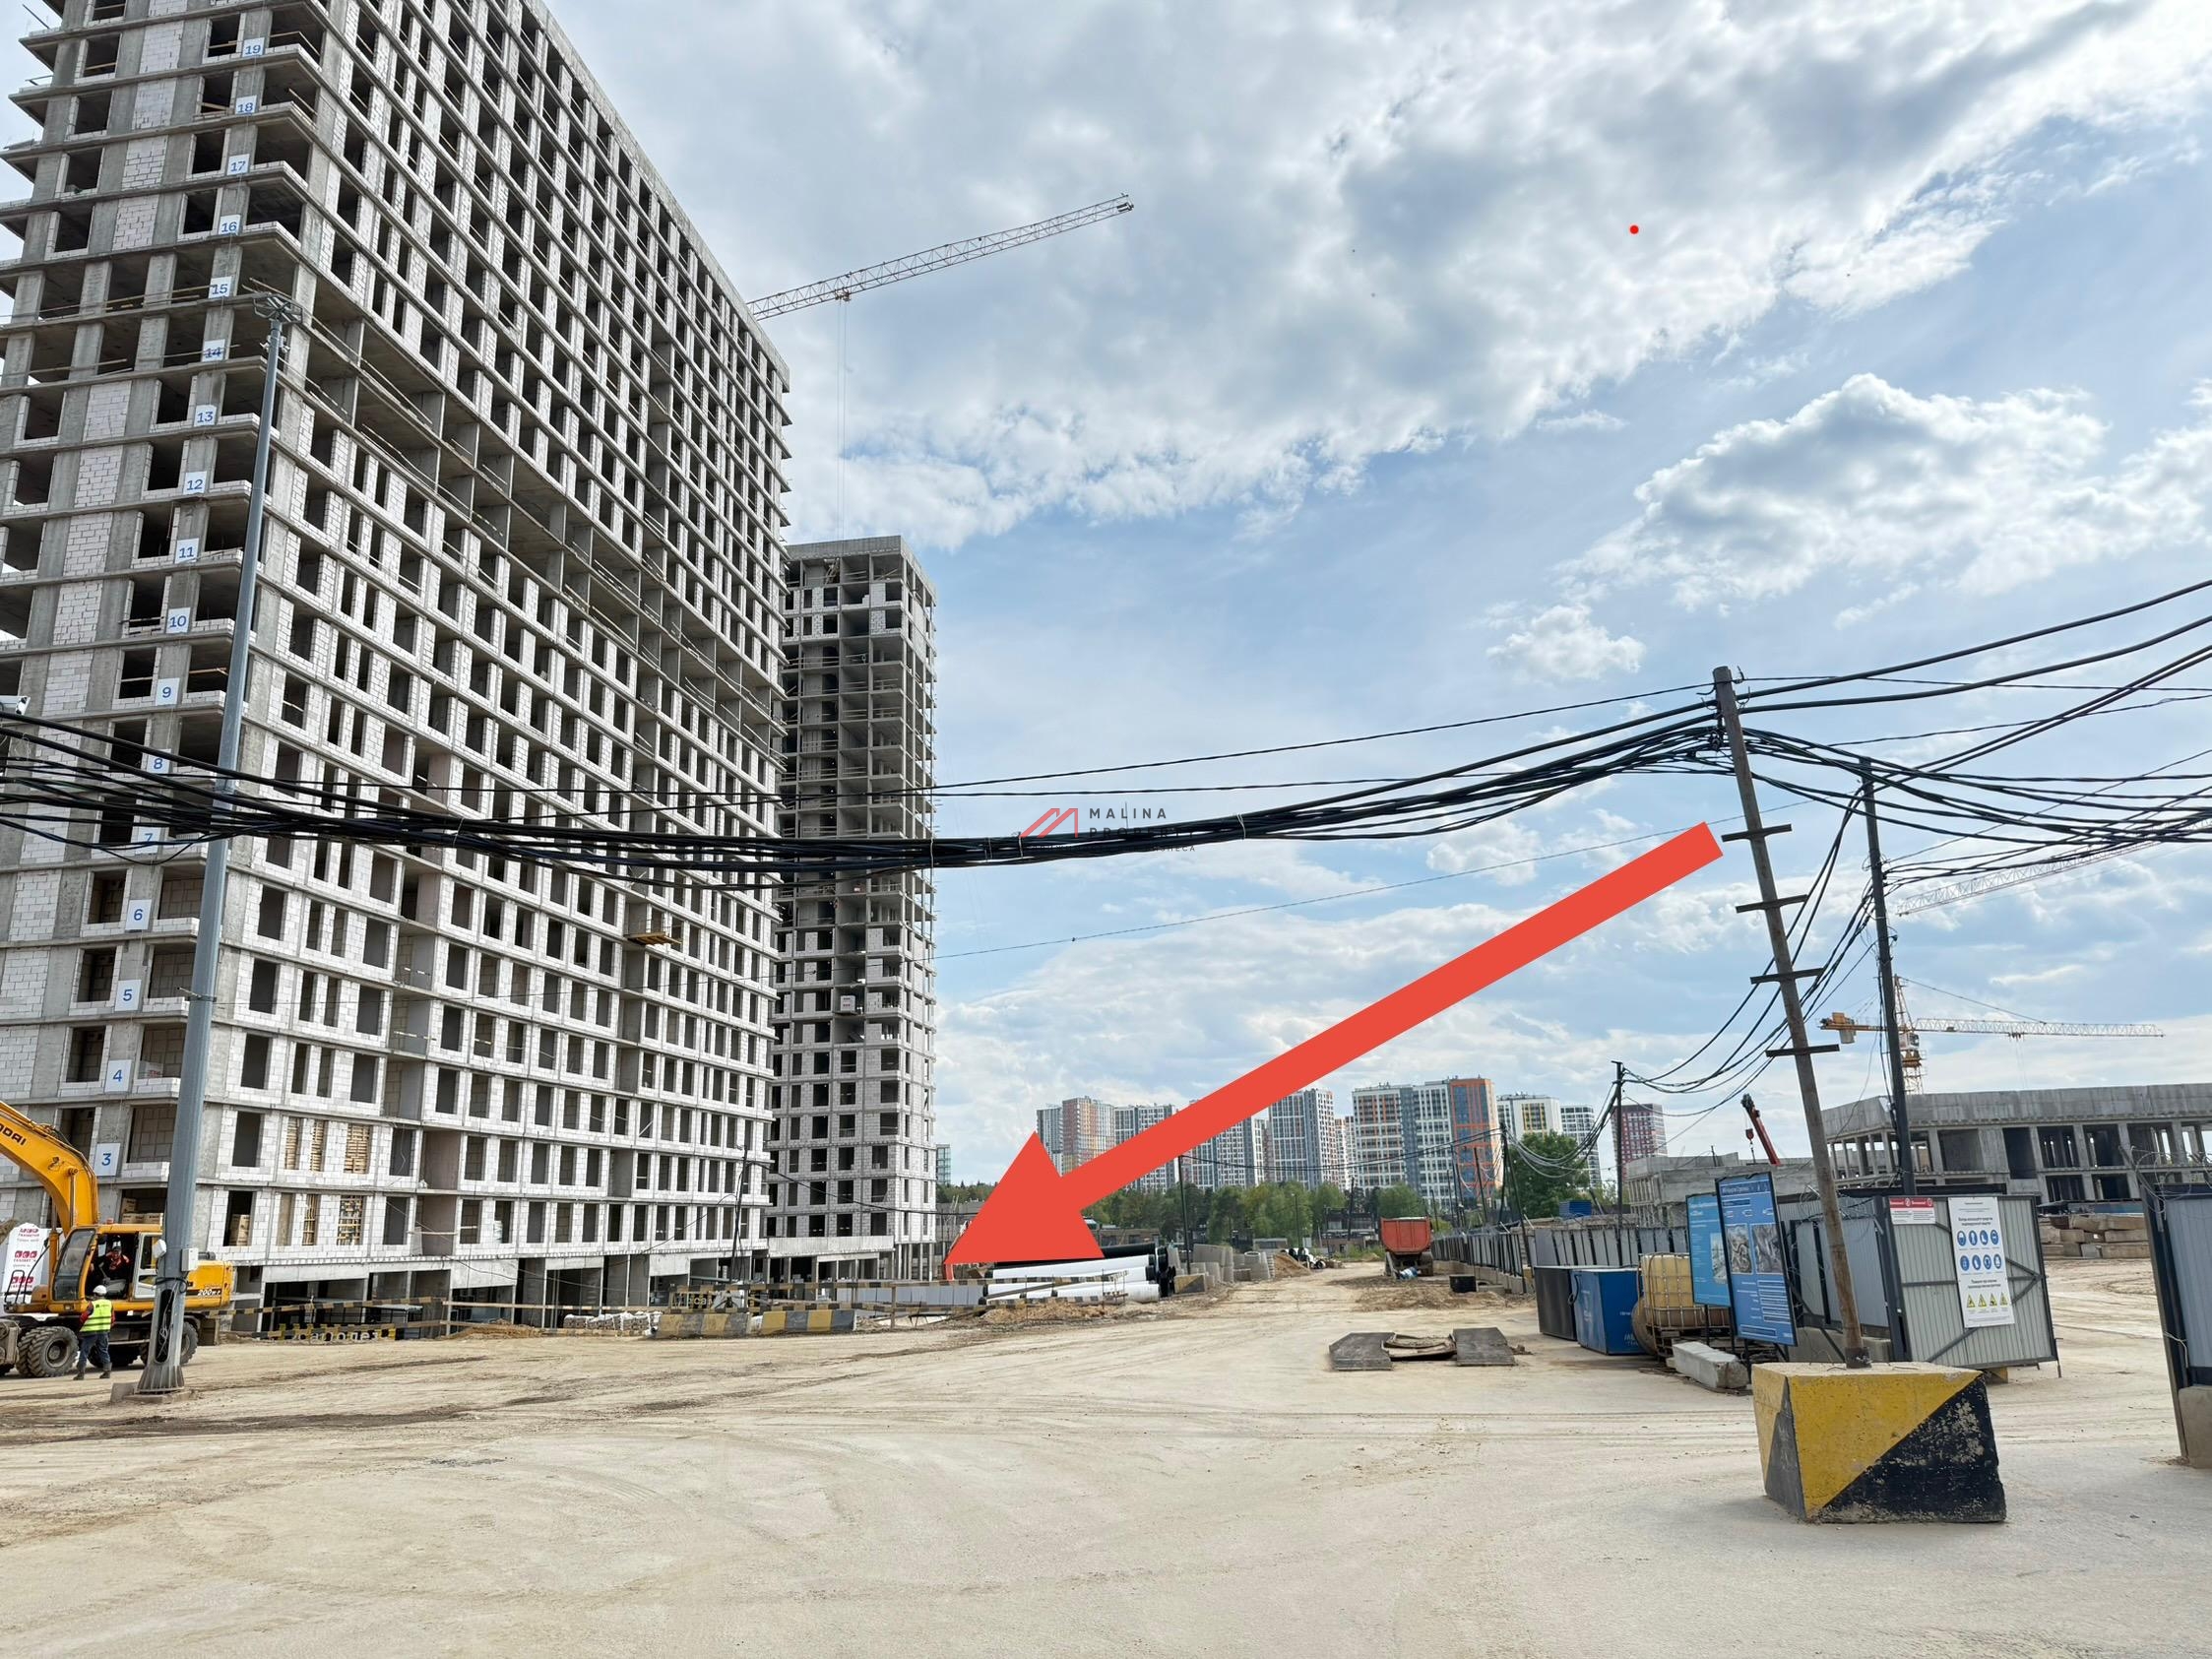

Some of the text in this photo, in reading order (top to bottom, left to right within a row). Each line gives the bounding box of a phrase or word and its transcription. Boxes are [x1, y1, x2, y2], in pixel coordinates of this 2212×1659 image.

[245, 44, 261, 55] 19
[237, 102, 254, 113] 18
[230, 160, 246, 172] 17
[221, 222, 237, 233] 16
[212, 284, 228, 295] 15
[204, 347, 222, 358] 14
[197, 411, 214, 423] 13
[187, 479, 204, 491] 12
[178, 546, 195, 558] 11
[169, 614, 187, 628] 10
[161, 686, 172, 699] 9
[154, 757, 163, 770] 8
[144, 832, 155, 844] 7
[133, 907, 144, 922] 6
[122, 989, 133, 1001] 5
[112, 1069, 123, 1083] 4
[101, 1152, 112, 1167] 3
